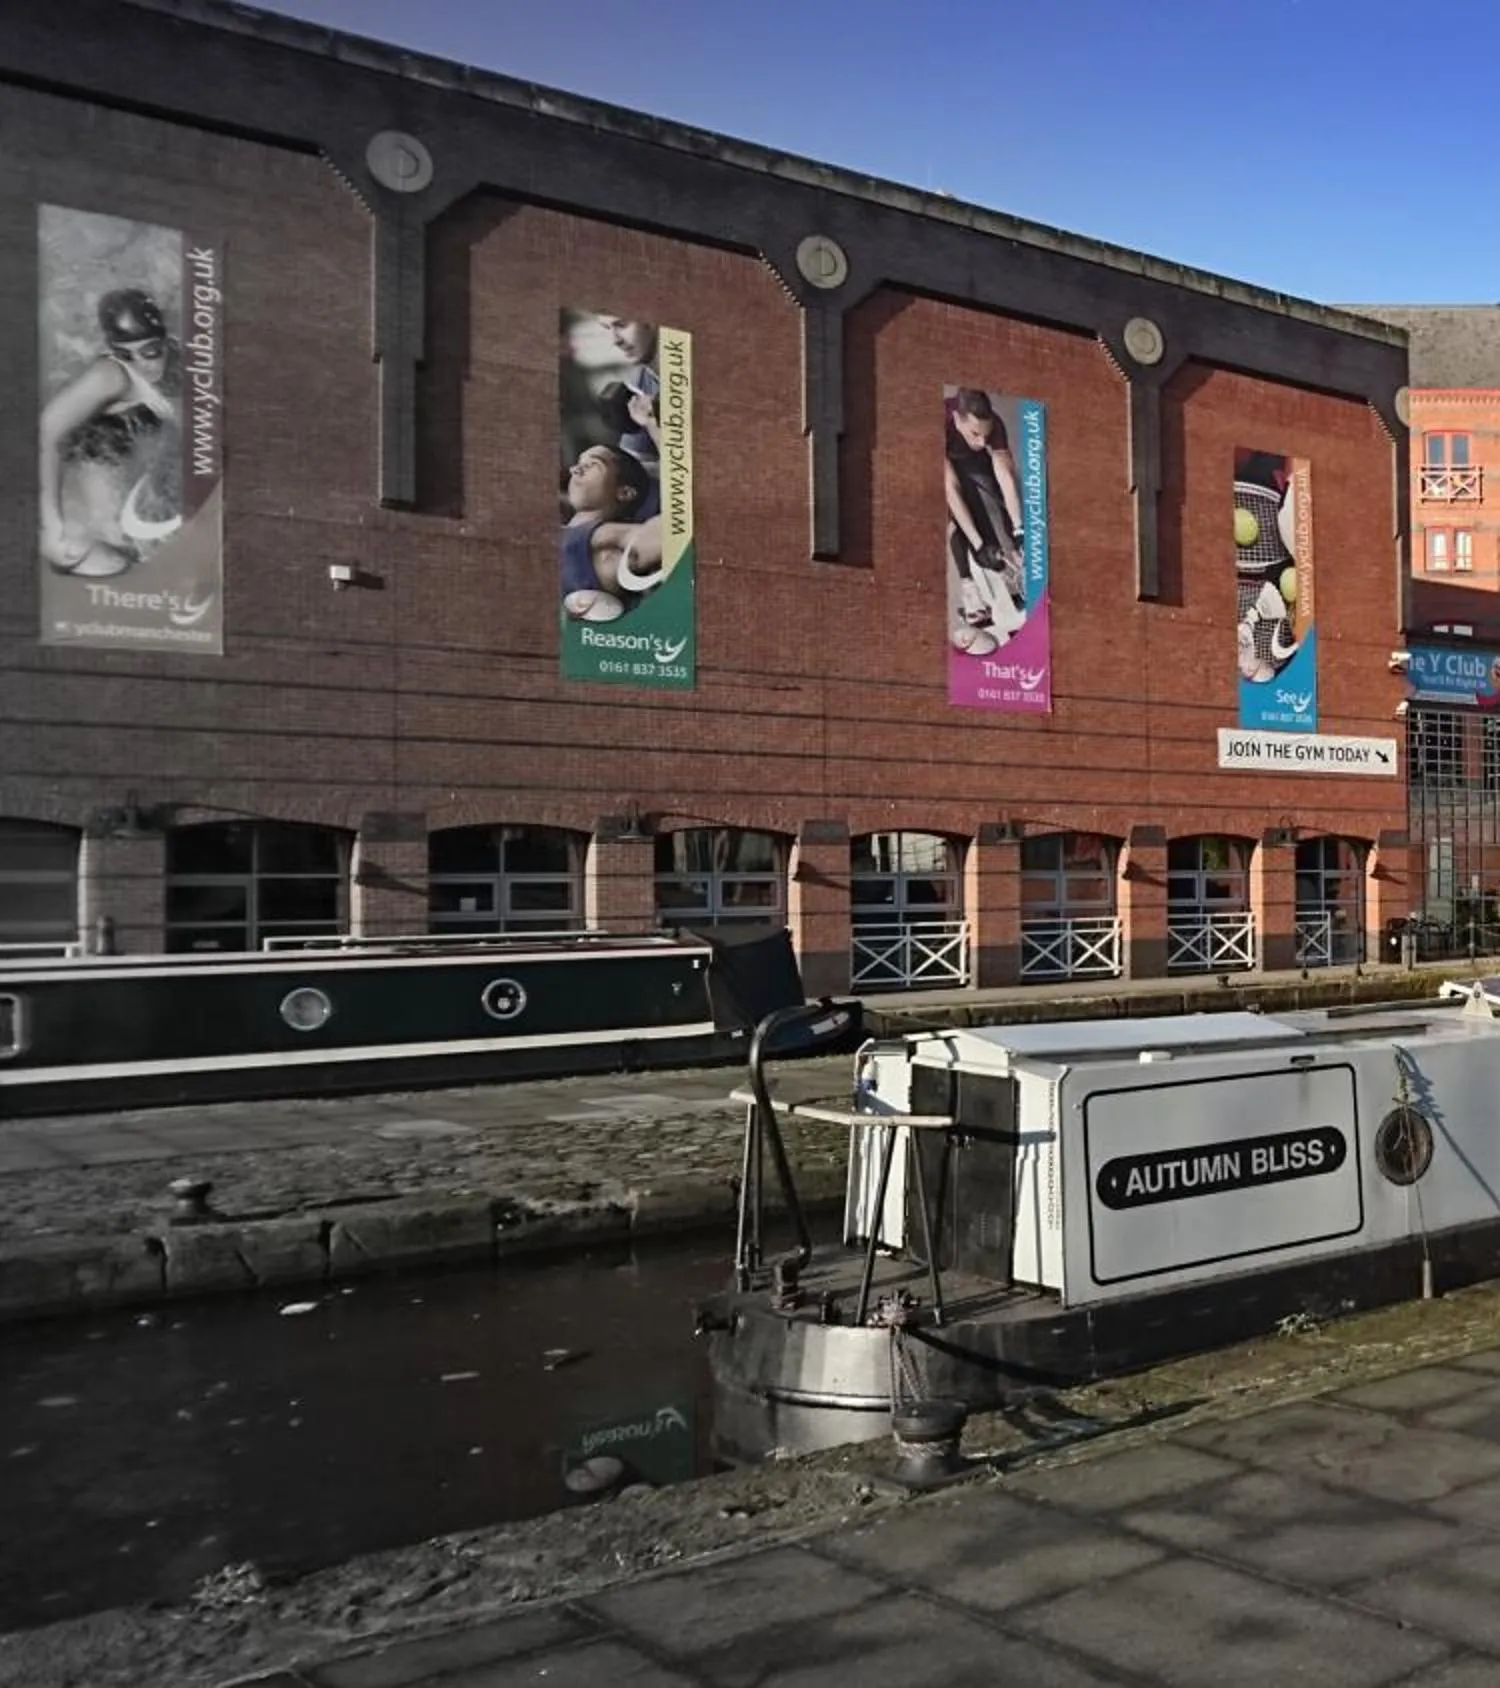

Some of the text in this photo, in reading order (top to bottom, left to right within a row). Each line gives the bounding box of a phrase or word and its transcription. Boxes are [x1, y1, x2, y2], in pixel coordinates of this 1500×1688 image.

[186, 247, 222, 476] www.yclub.org.uk
[664, 339, 688, 536] www.yclub.org.uk
[1023, 409, 1047, 581] www.yclub.org.uk
[1295, 467, 1312, 617] www.yclub.org.uk
[84, 582, 181, 611] There's
[581, 627, 662, 651] Reason's
[599, 660, 629, 673] 0161
[981, 660, 1027, 681] That's
[1428, 652, 1441, 673] Y
[1445, 655, 1487, 677] Club
[1276, 688, 1297, 705] See
[1226, 741, 1371, 763] JOIN THE GYM TODAY
[1125, 1139, 1325, 1197] AUTUMN BLISS
